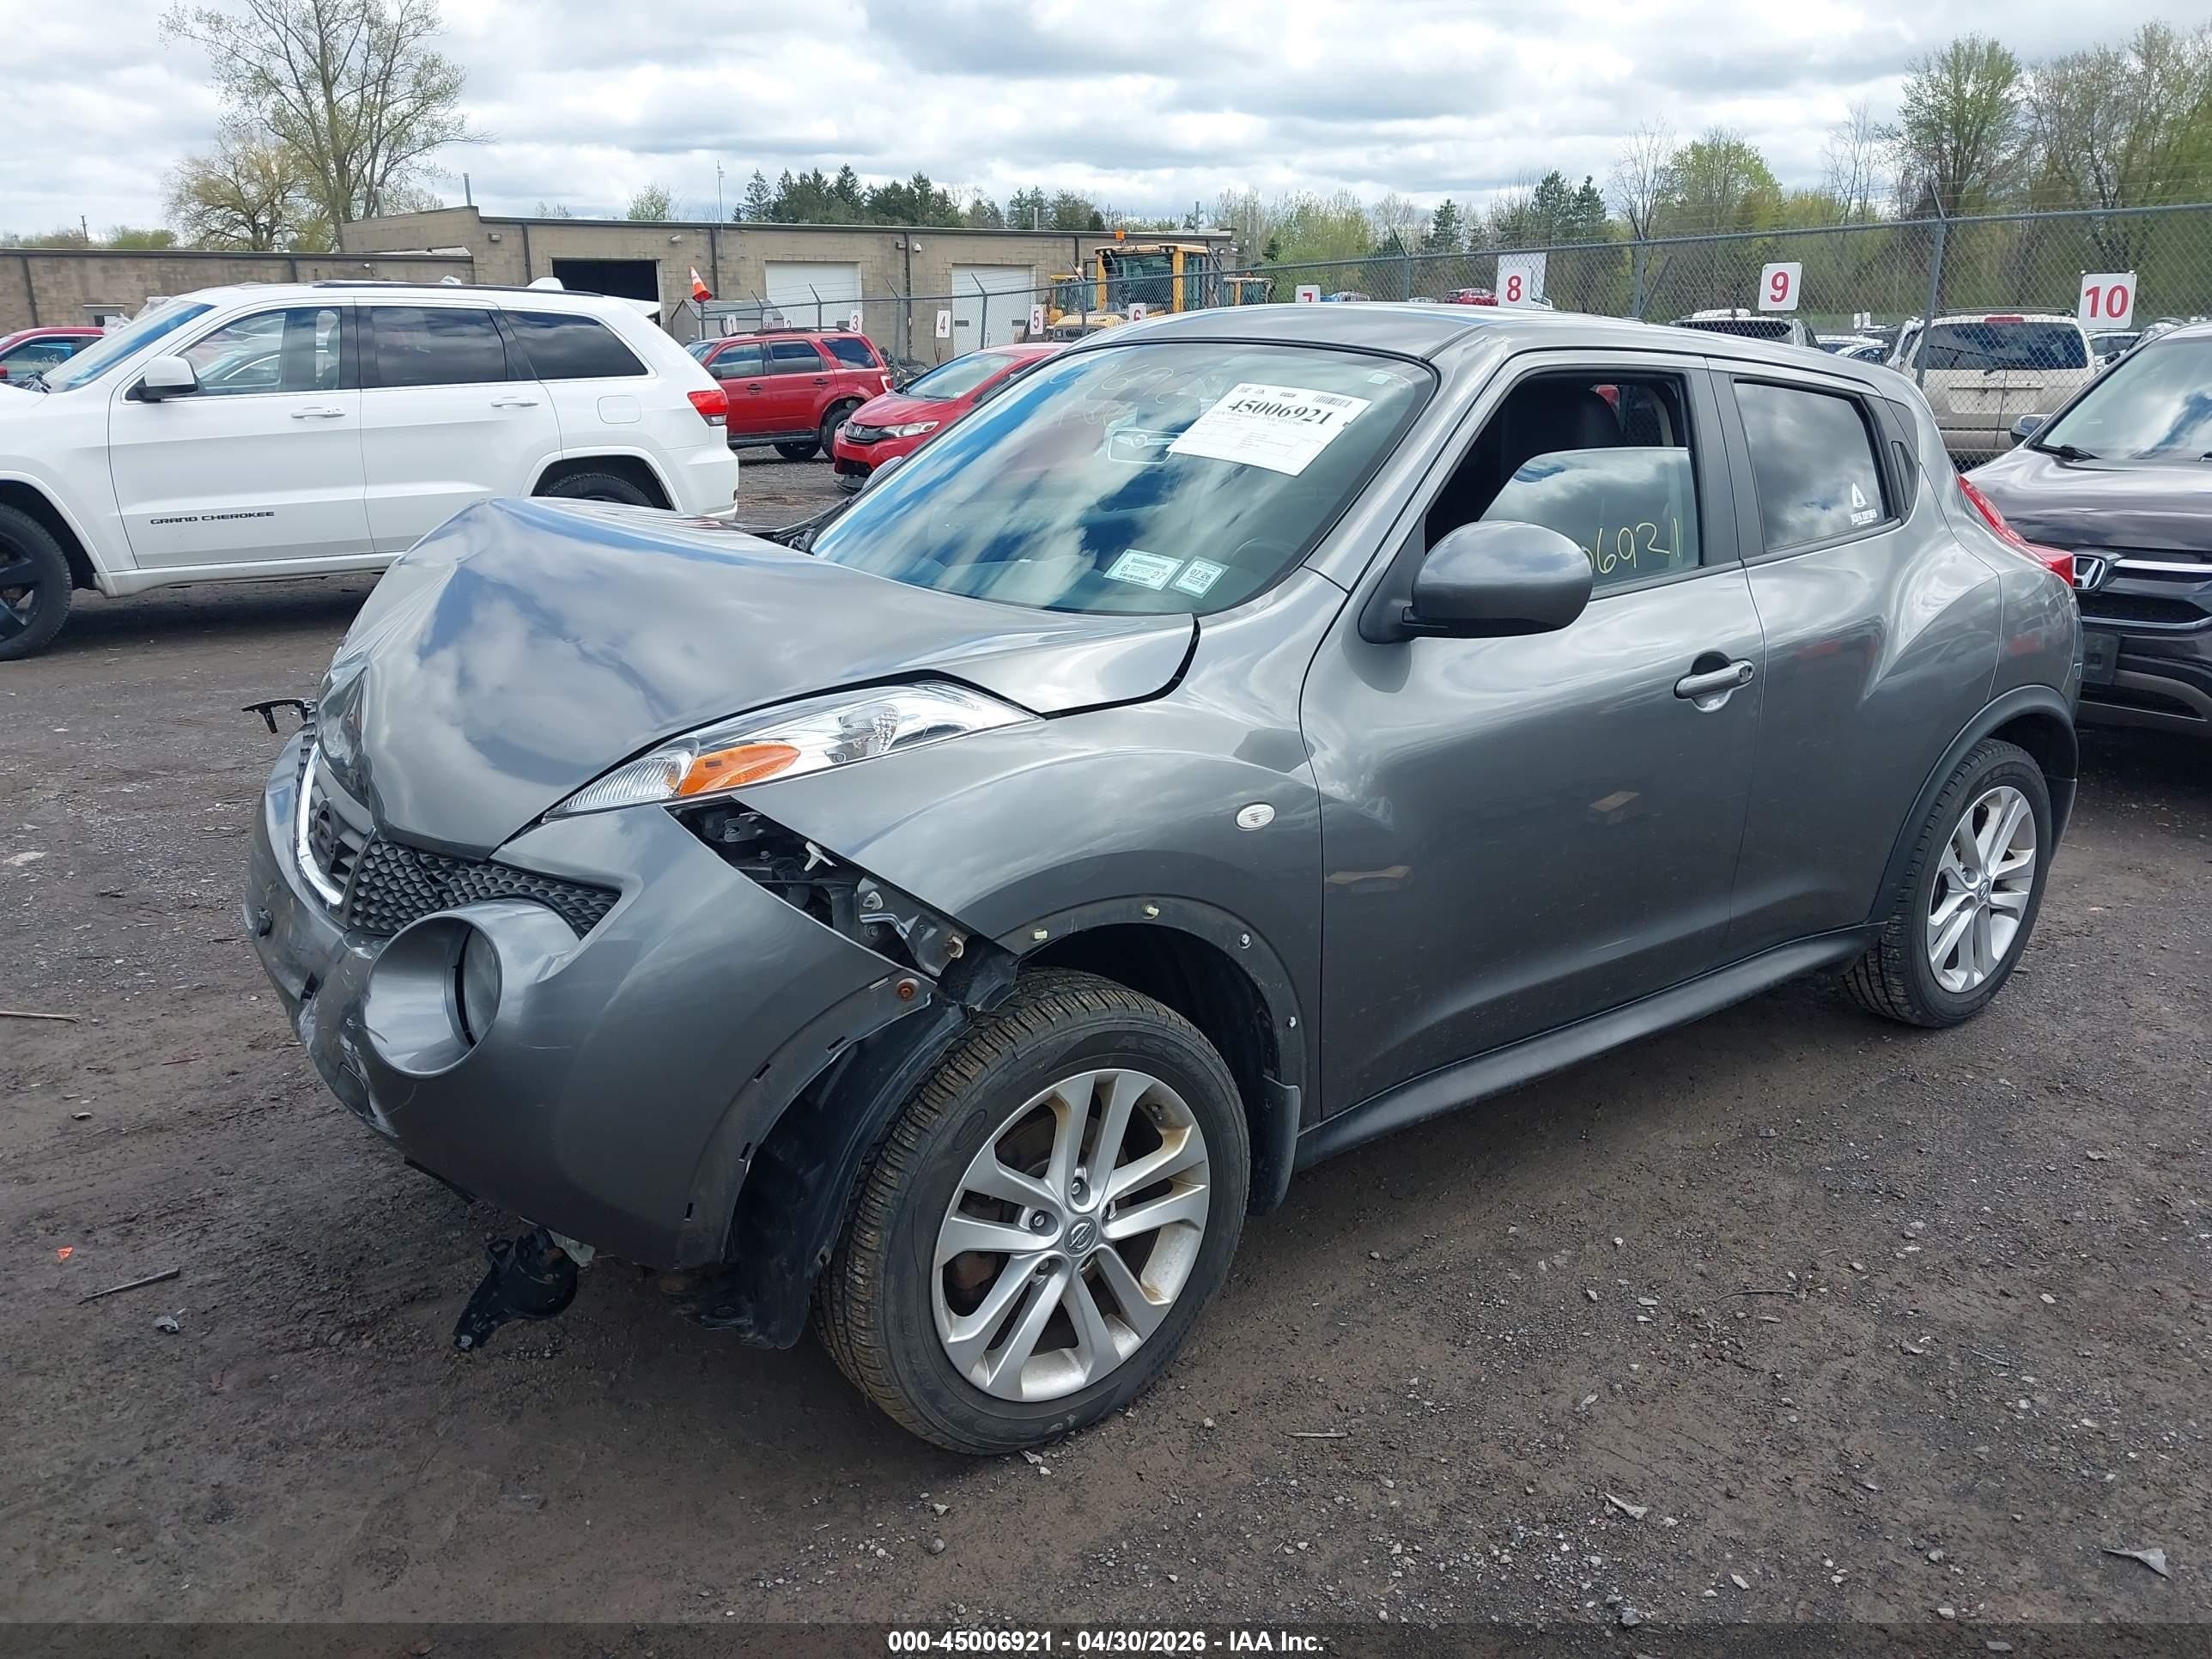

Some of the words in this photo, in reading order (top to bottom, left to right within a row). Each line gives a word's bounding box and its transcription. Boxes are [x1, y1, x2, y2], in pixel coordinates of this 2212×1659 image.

[1507, 275, 1522, 301] 8
[1771, 271, 1789, 302] 9
[2085, 285, 2129, 318] 10
[852, 314, 859, 331] 3
[939, 315, 945, 332] 4
[1034, 310, 1039, 329] 5
[1228, 398, 1334, 425] 45006921
[202, 511, 276, 521] CHEROKEE
